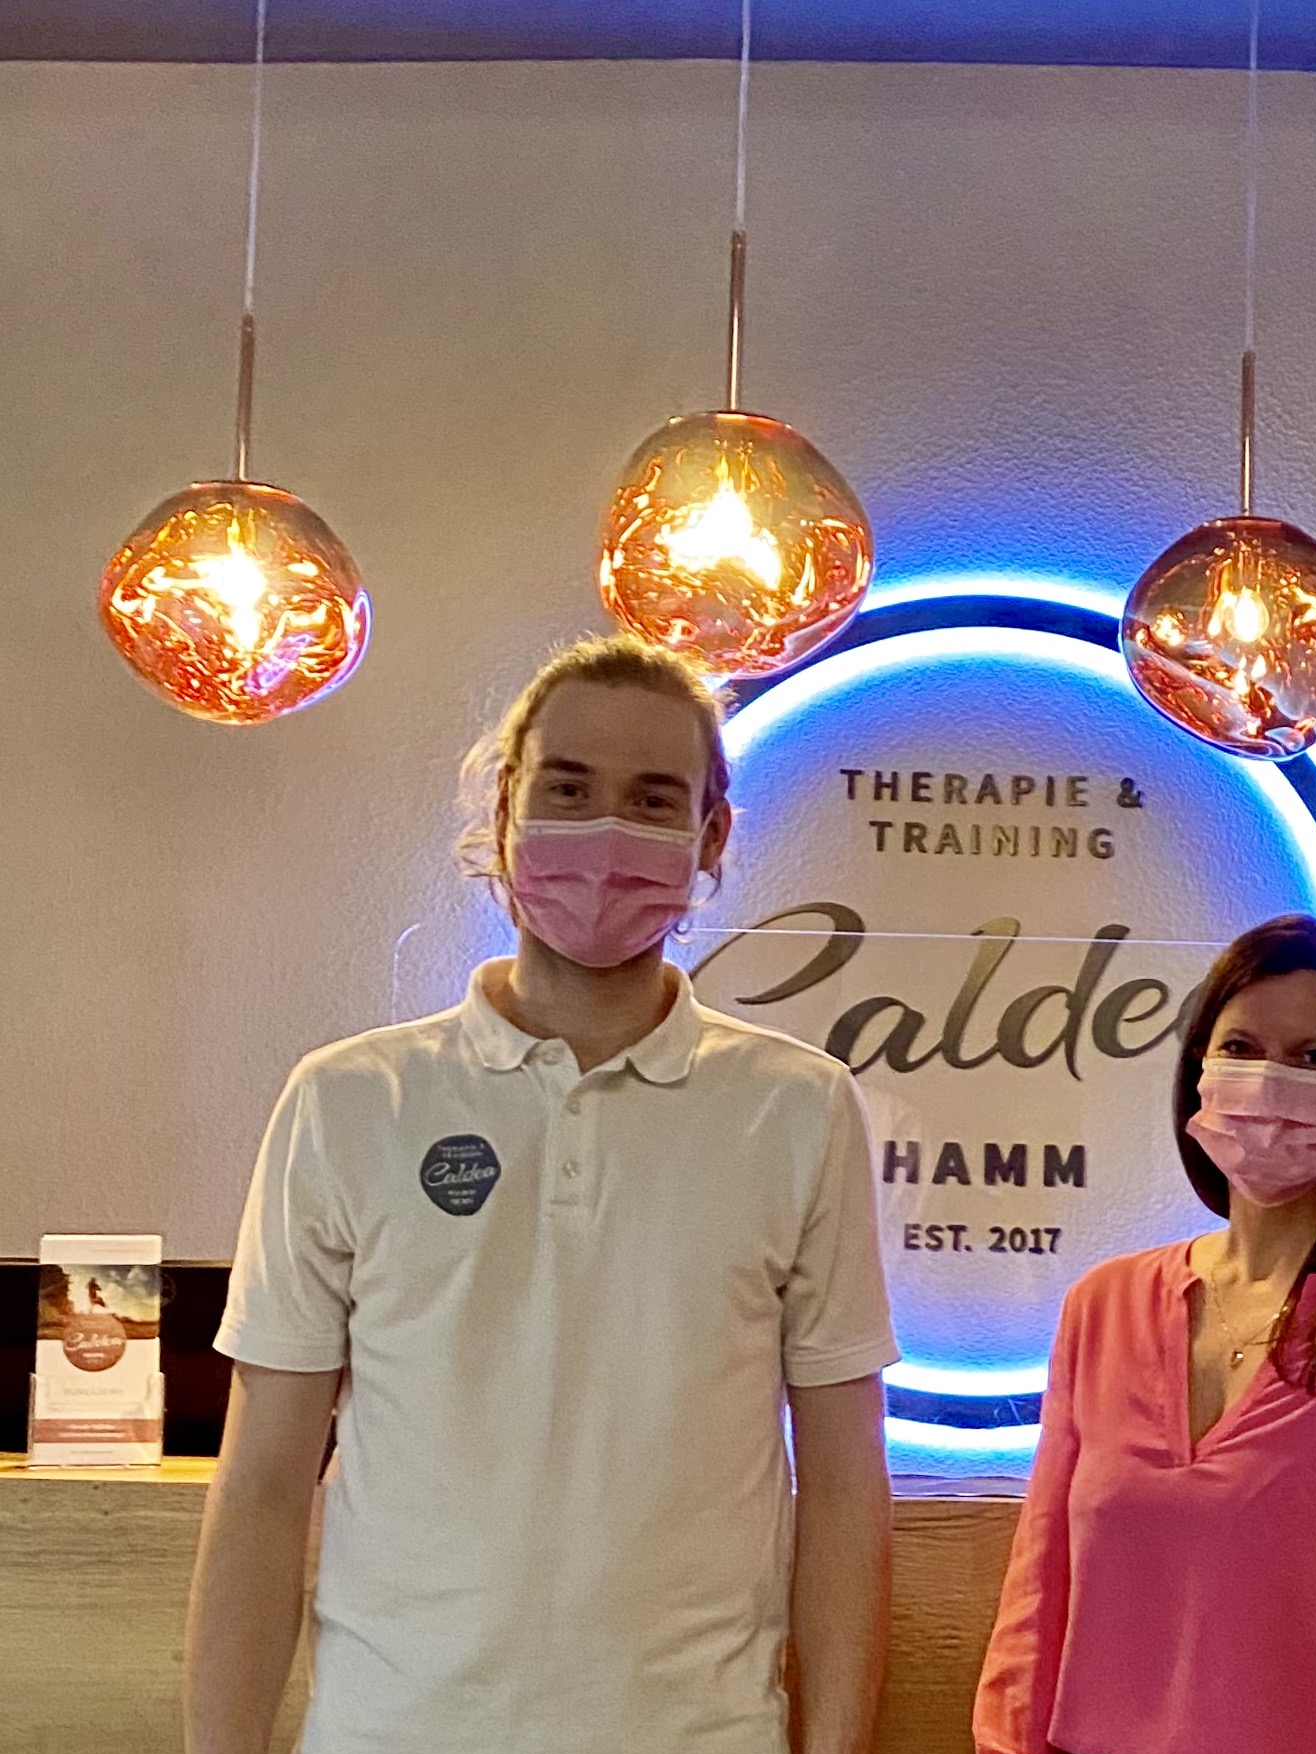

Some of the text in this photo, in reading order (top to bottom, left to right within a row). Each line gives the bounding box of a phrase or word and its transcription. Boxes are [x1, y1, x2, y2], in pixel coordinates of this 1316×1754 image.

[839, 768, 1146, 809] THERAPIE &
[868, 819, 1117, 860] TRAINING
[689, 901, 1212, 1082] Calde
[882, 1139, 1087, 1188] HAMM
[903, 1222, 1063, 1255] EST. 2017
